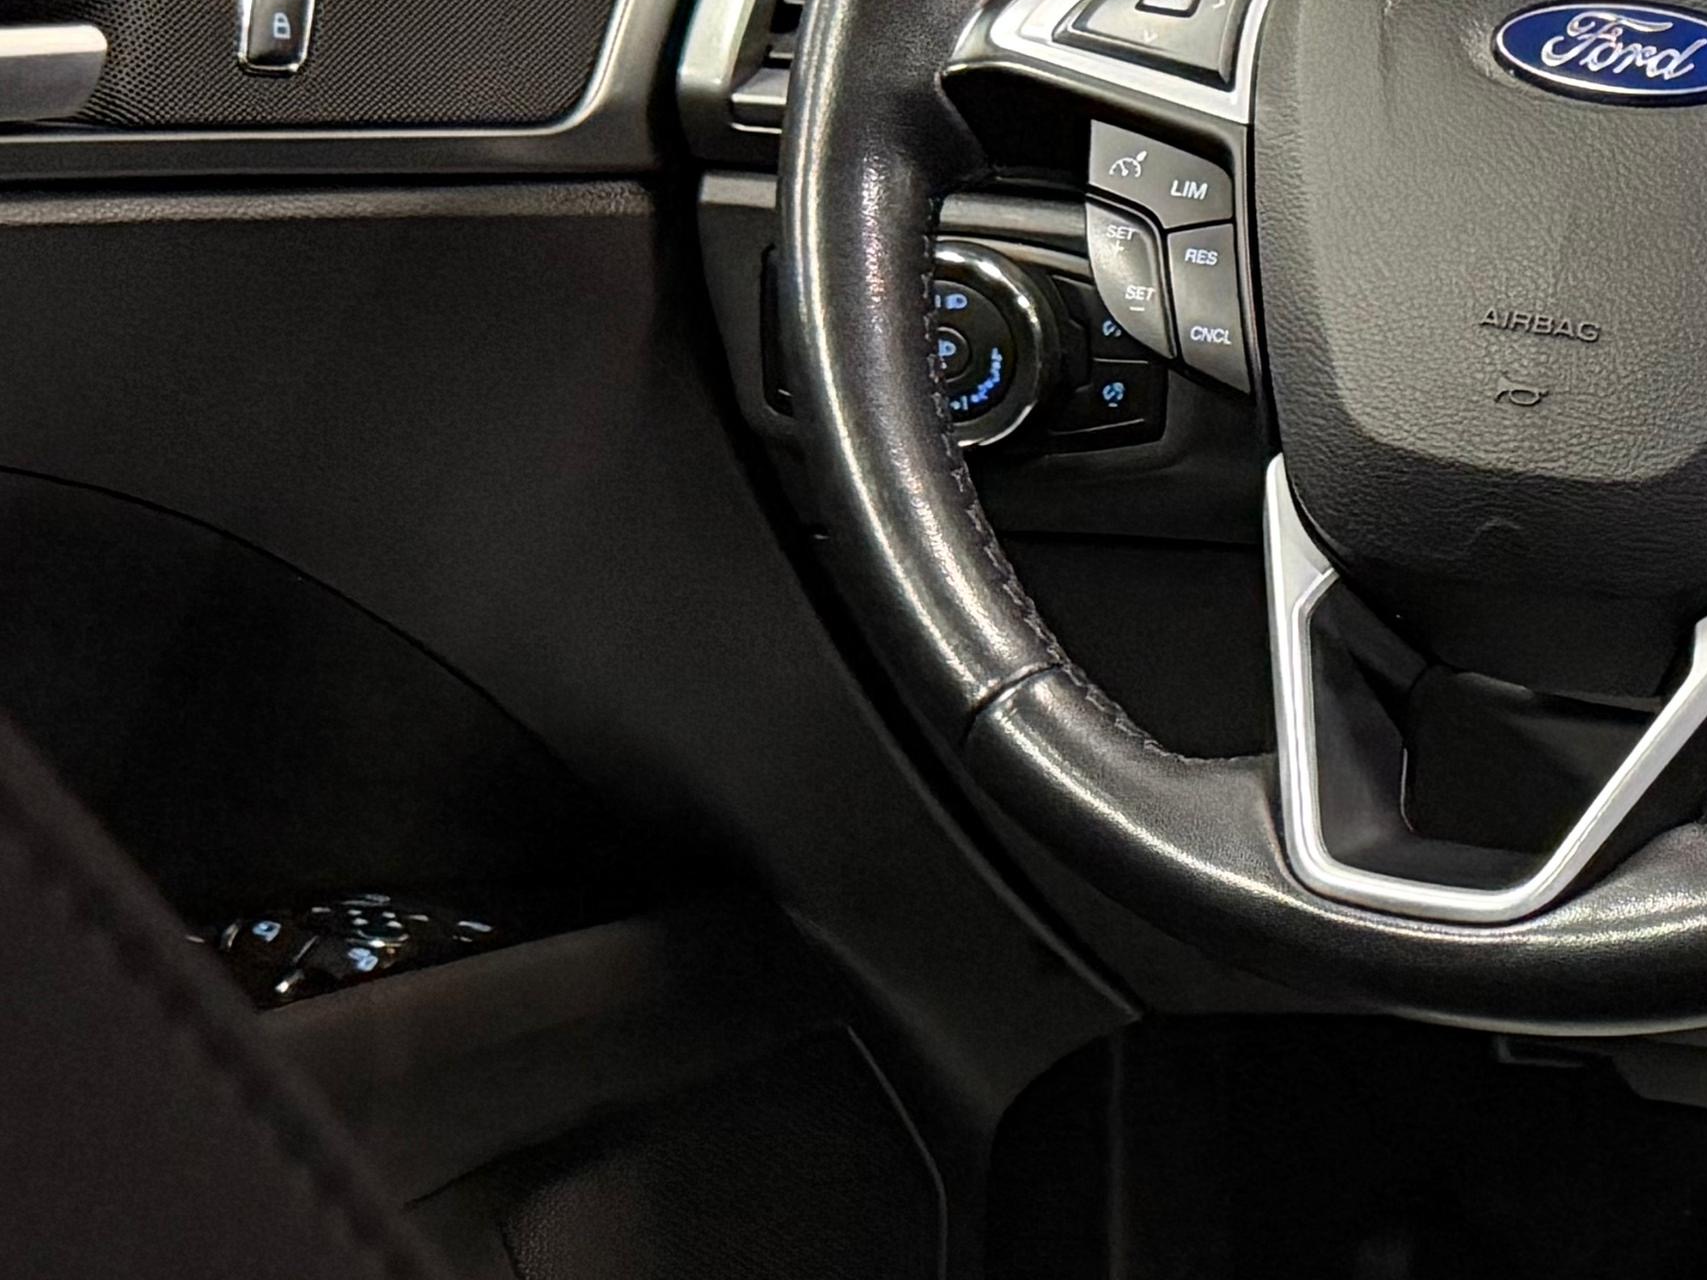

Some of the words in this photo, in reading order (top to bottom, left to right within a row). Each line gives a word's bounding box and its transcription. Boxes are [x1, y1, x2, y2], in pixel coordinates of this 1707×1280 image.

[1170, 179, 1208, 201] LIM
[1105, 224, 1136, 242] SET
[1184, 247, 1219, 267] RES
[1124, 285, 1156, 303] SET
[1190, 325, 1232, 345] CNCL
[1479, 309, 1600, 342] AIRBAG
